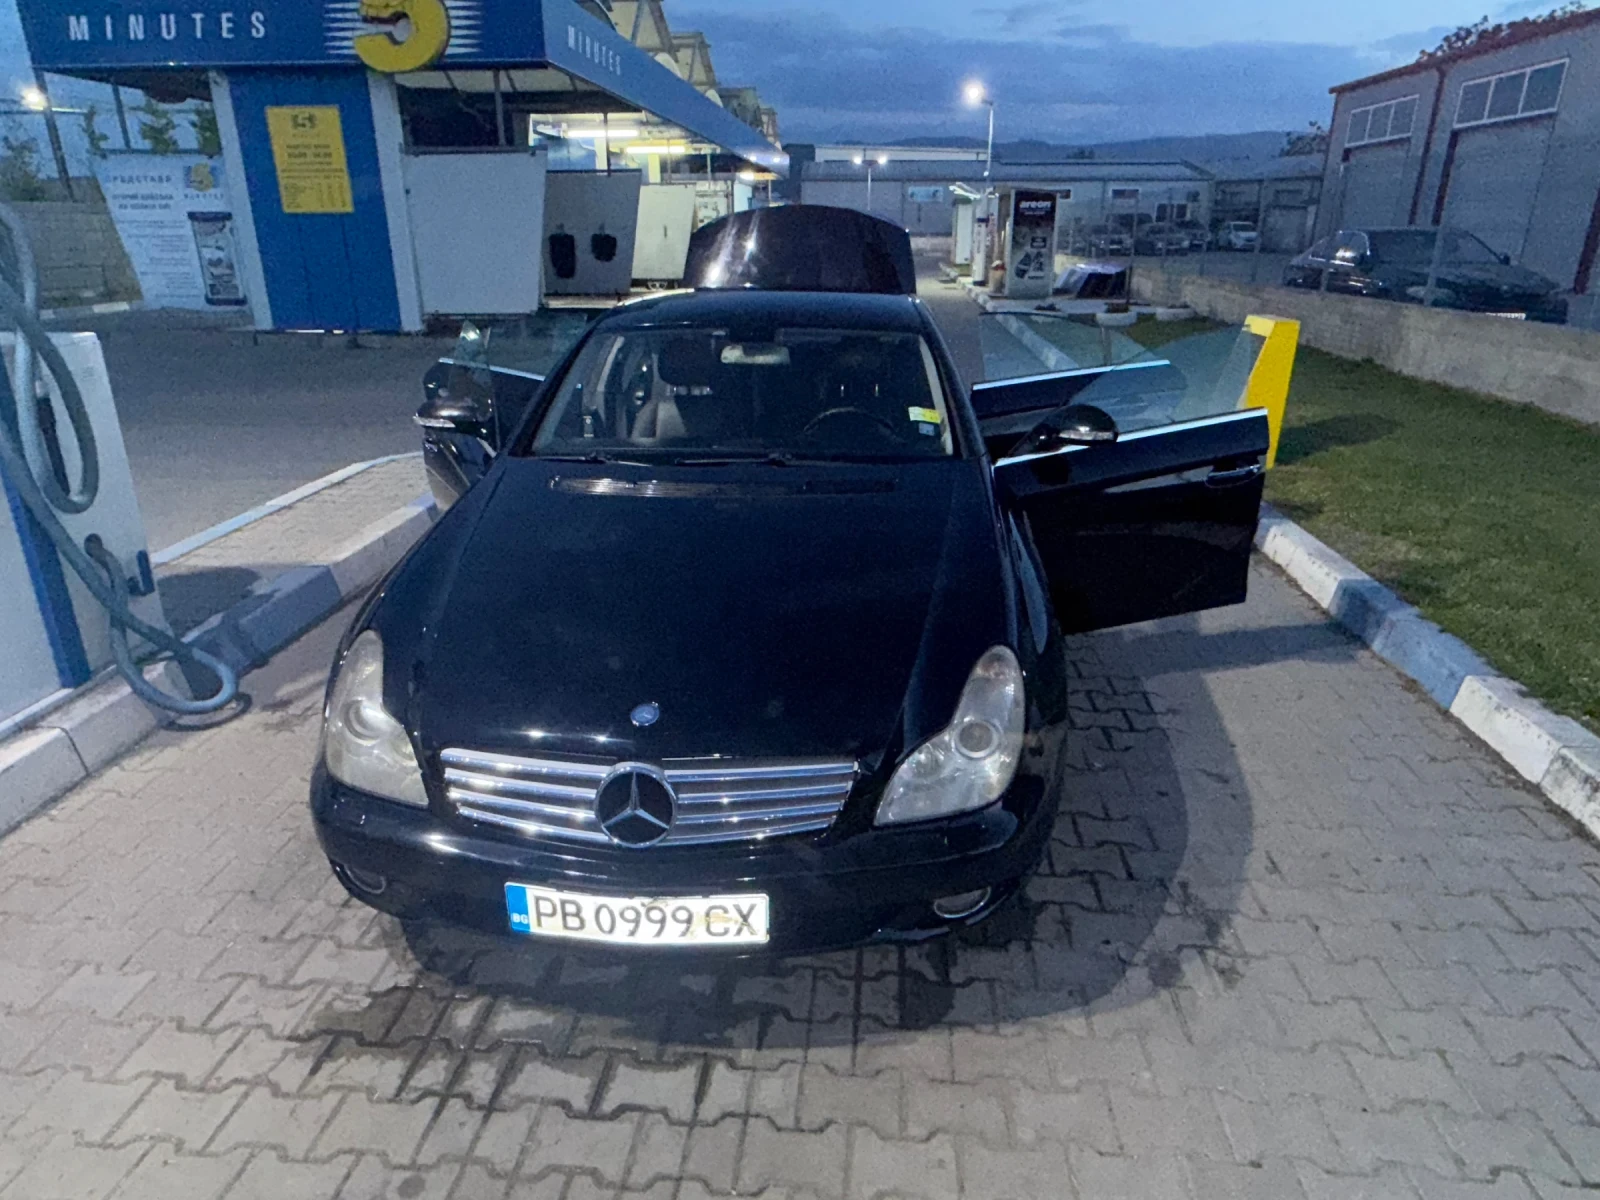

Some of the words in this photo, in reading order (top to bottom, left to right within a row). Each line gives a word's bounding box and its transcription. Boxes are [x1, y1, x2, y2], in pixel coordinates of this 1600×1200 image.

[68, 11, 265, 41] MINUTES
[567, 25, 621, 76] MINUTES
[513, 913, 529, 924] BG
[533, 895, 586, 932] PB
[594, 902, 695, 938] 0999
[704, 903, 758, 937] CX
